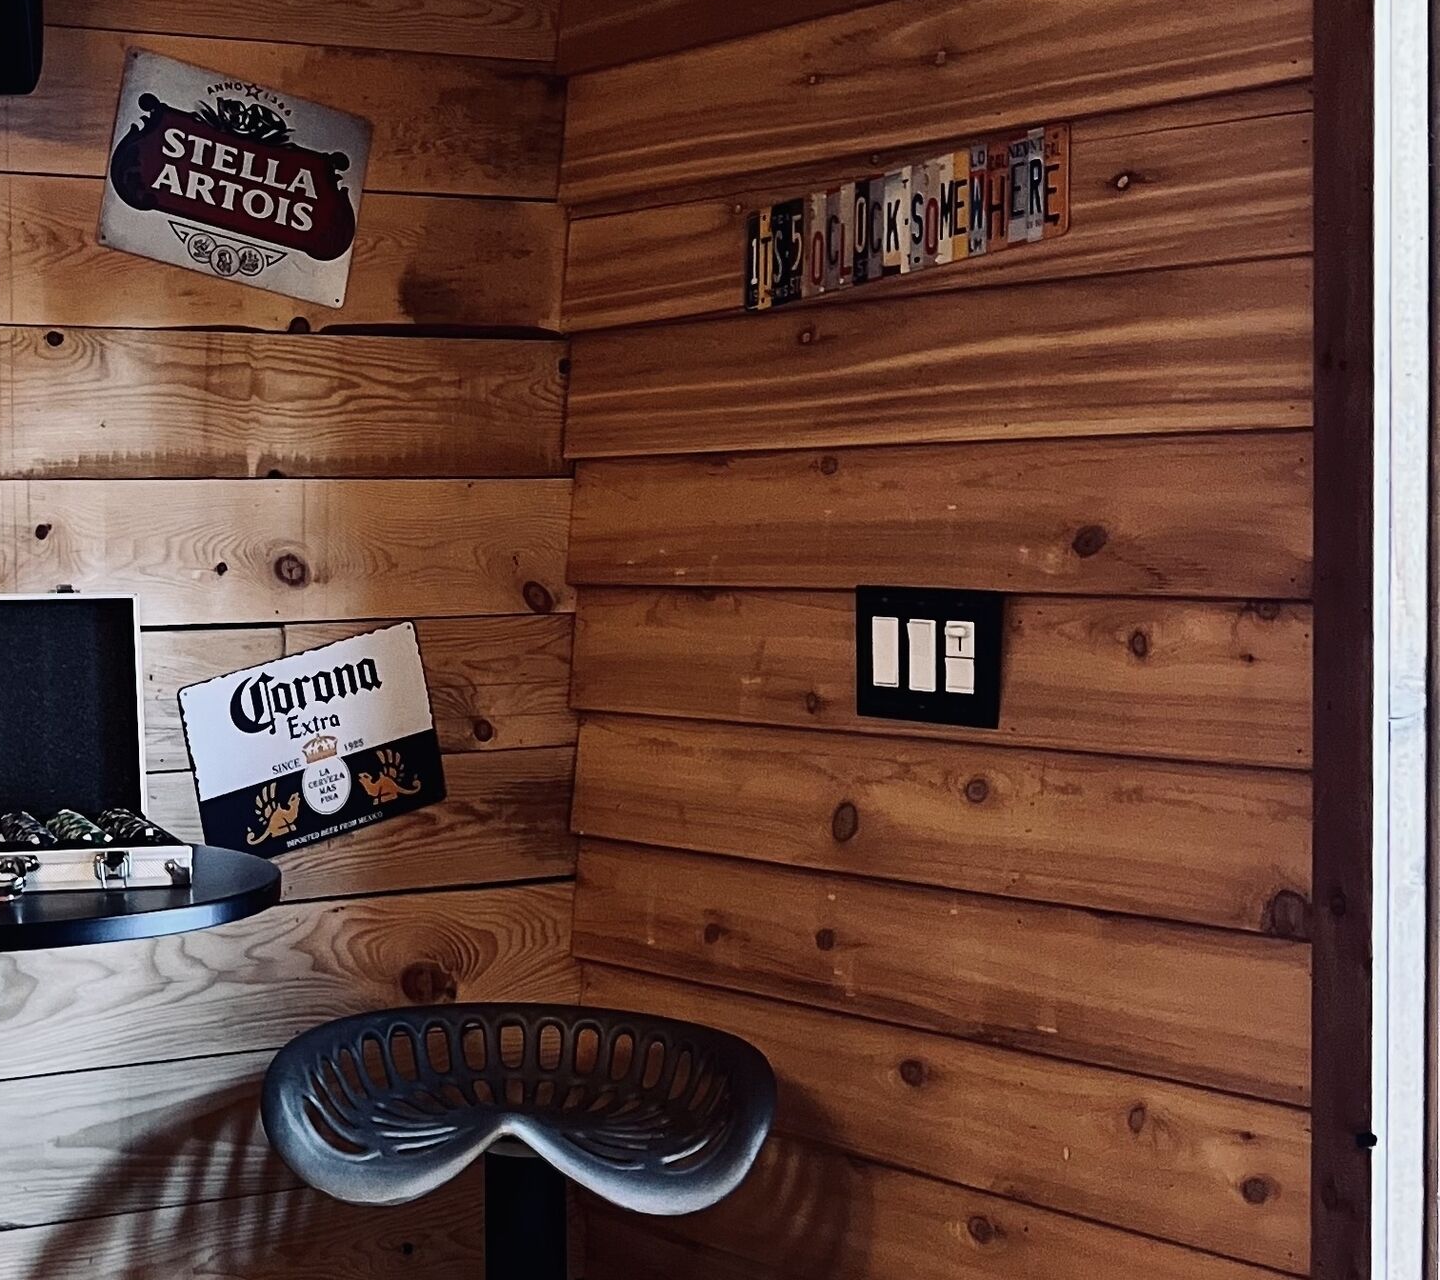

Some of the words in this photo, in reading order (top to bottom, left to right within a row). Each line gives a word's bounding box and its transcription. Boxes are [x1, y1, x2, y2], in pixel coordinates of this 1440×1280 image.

[207, 82, 243, 95] ANNO
[162, 128, 318, 200] STELLA
[151, 164, 314, 232] ARTOIS
[229, 657, 383, 735] Corona
[288, 713, 341, 740] Extra
[343, 738, 364, 752] 1925
[271, 758, 302, 775] SINCE
[319, 768, 331, 777] LA
[308, 772, 346, 789] CERVEZA
[286, 831, 320, 848] IMPORTED
[320, 823, 339, 837] BEER
[339, 818, 357, 831] FROM
[358, 810, 384, 825] MEXICO
